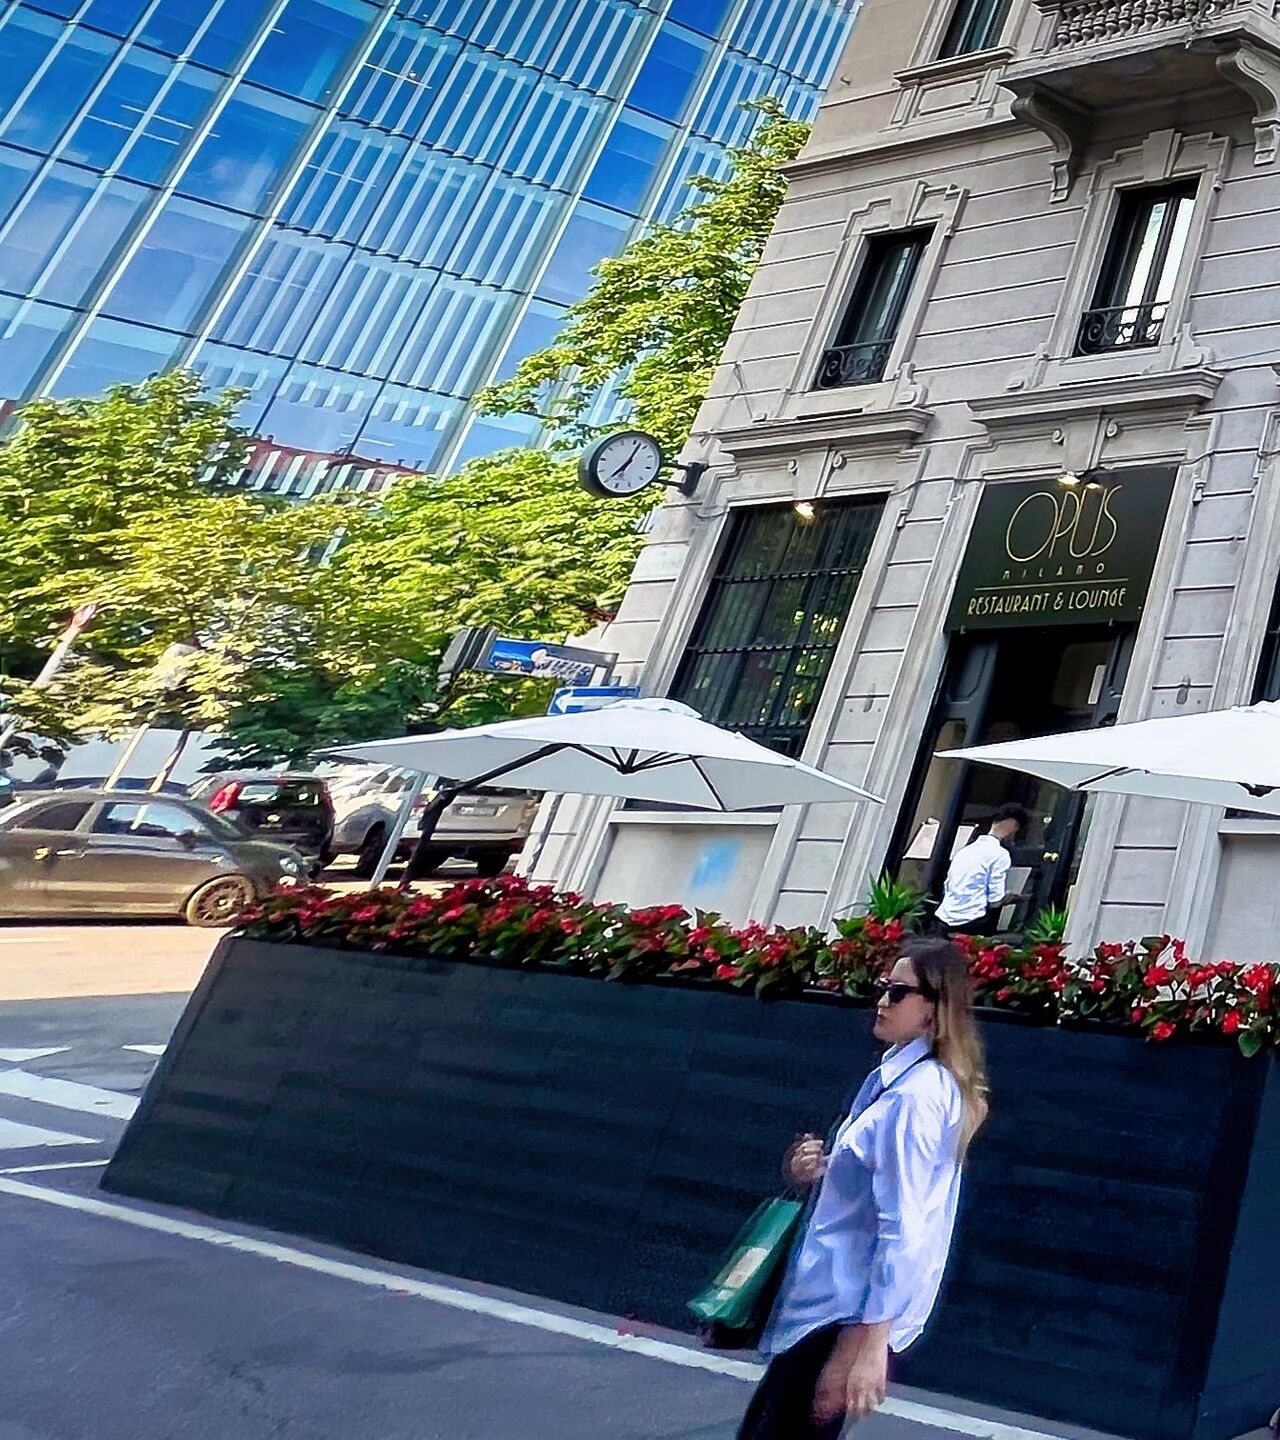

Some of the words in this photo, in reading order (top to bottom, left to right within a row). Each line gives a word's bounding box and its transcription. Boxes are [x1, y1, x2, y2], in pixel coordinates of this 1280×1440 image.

[1005, 484, 1122, 562] OPUS
[1001, 562, 1105, 580] MILANO
[967, 592, 1051, 616] RESTAURANT
[1053, 592, 1064, 610] &
[1068, 587, 1128, 610] LOUNGE
